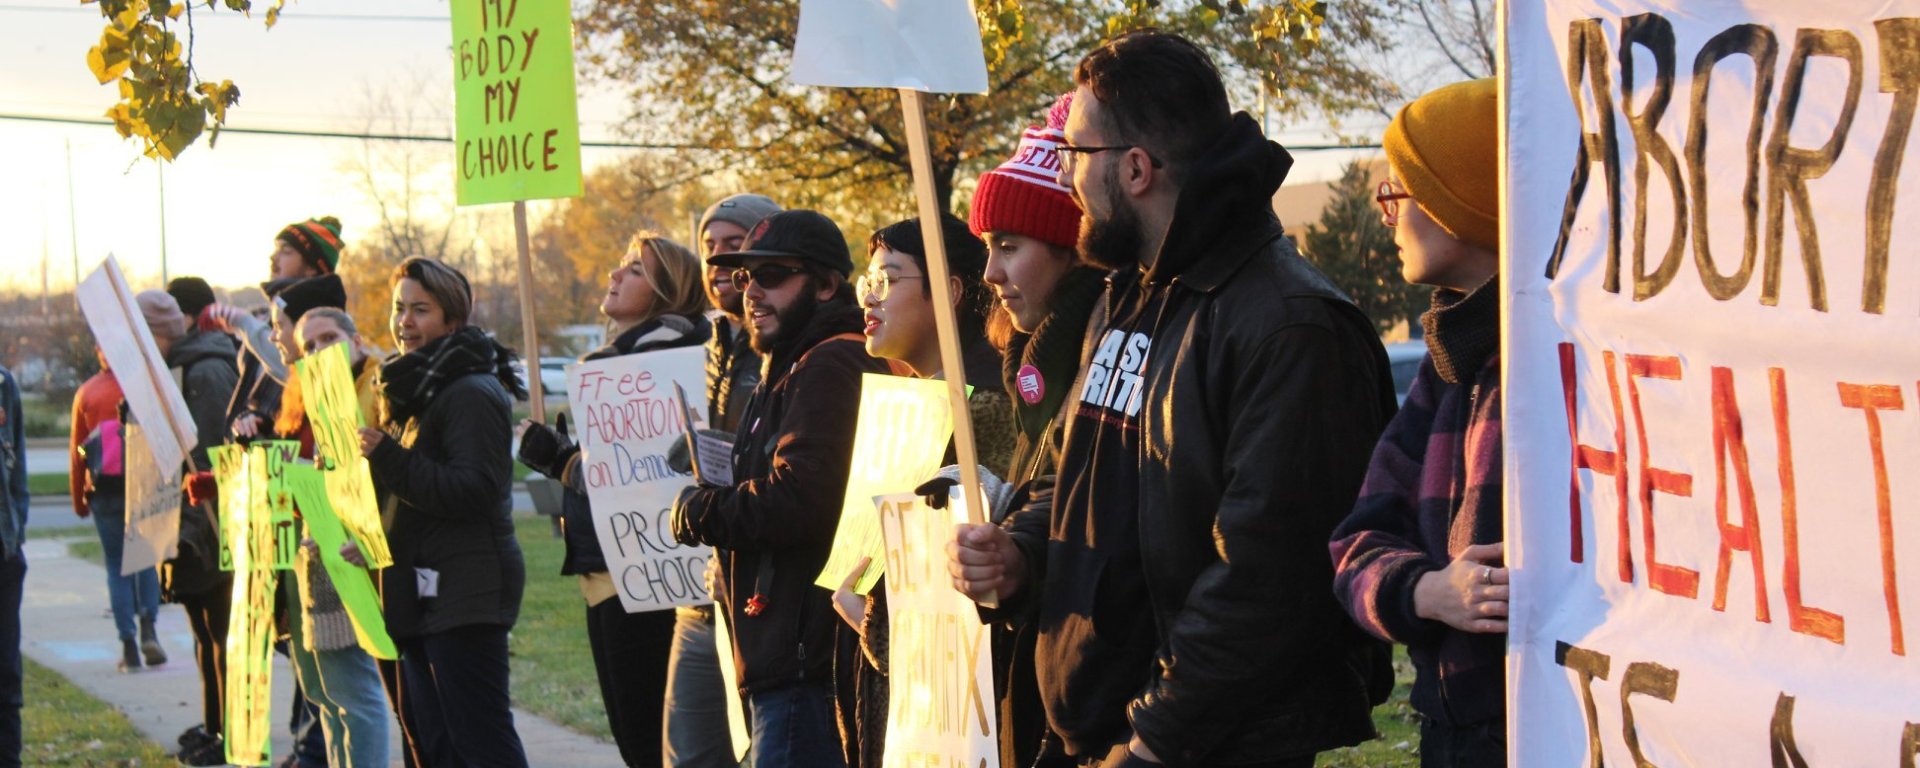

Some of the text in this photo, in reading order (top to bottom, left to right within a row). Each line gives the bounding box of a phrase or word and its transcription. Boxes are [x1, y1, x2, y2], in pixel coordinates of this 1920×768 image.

[460, 28, 539, 80] BODY
[485, 77, 521, 125] MY
[462, 129, 559, 180] CHOICE
[1545, 12, 1920, 314] ABORT
[578, 371, 656, 402] Free
[587, 397, 683, 446] ABORTION
[588, 461, 615, 488] on
[1558, 342, 1920, 656] HEALT
[622, 554, 713, 604] CHOIC
